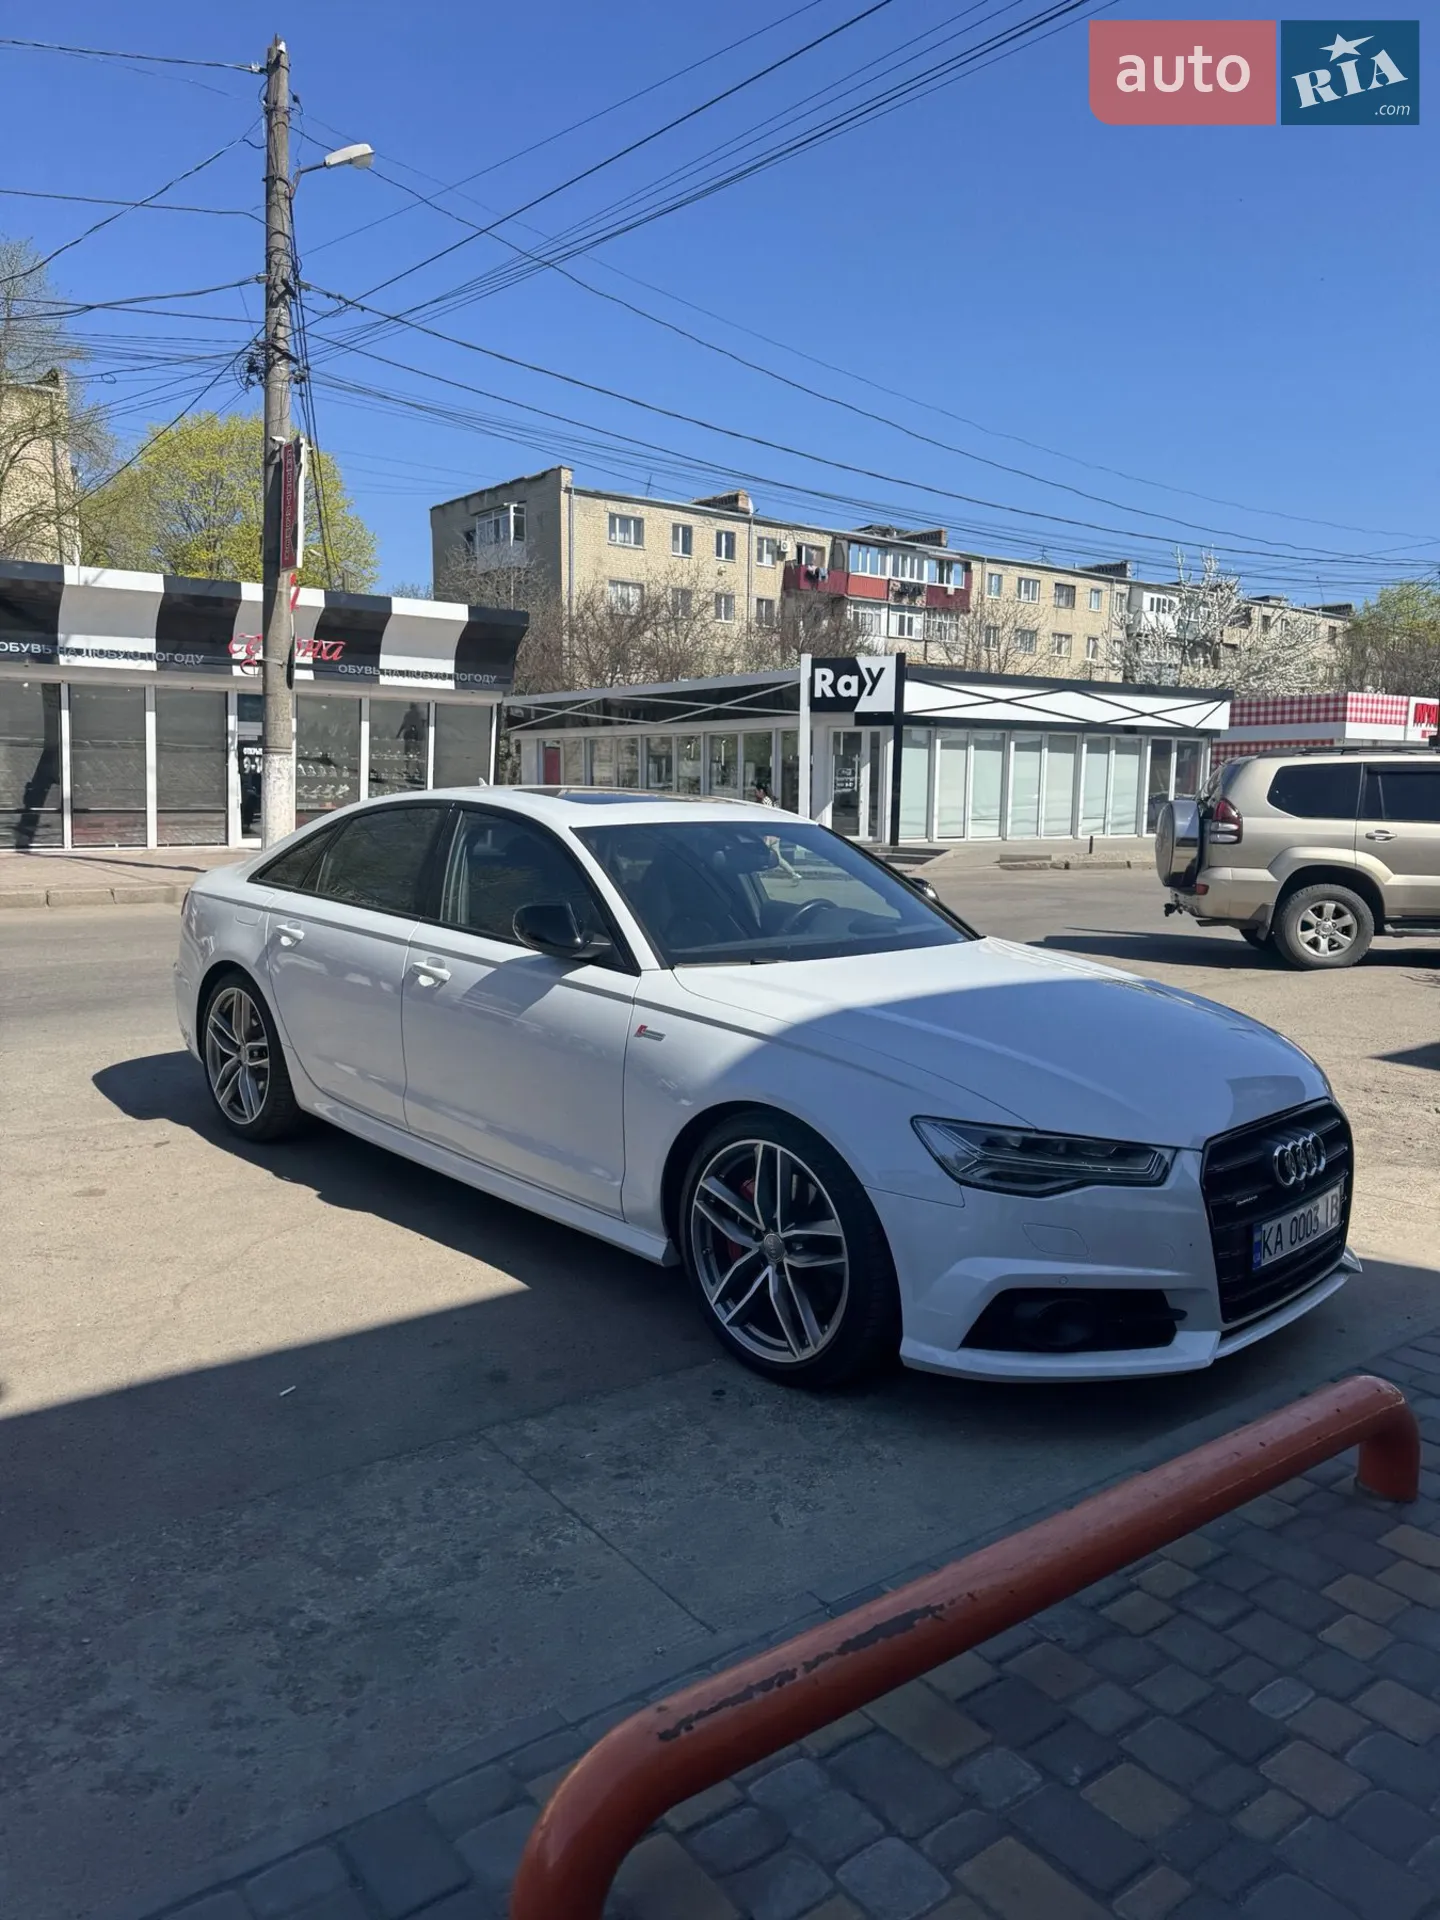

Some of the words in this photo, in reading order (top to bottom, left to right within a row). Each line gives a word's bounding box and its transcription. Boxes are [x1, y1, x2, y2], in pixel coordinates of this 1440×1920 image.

[0, 641, 52, 655] ОБУВЬ
[57, 645, 78, 657] НА
[81, 647, 142, 662] ЛЮБУЮ
[145, 651, 205, 665] ПОГОДУ
[338, 663, 380, 676] ОБУВЬ
[384, 668, 400, 678] НА
[402, 669, 449, 682] ЛЮБУЮ
[452, 672, 498, 684] ПОГОДУ
[1262, 1222, 1284, 1260] KA
[1290, 1203, 1320, 1247] 0003
